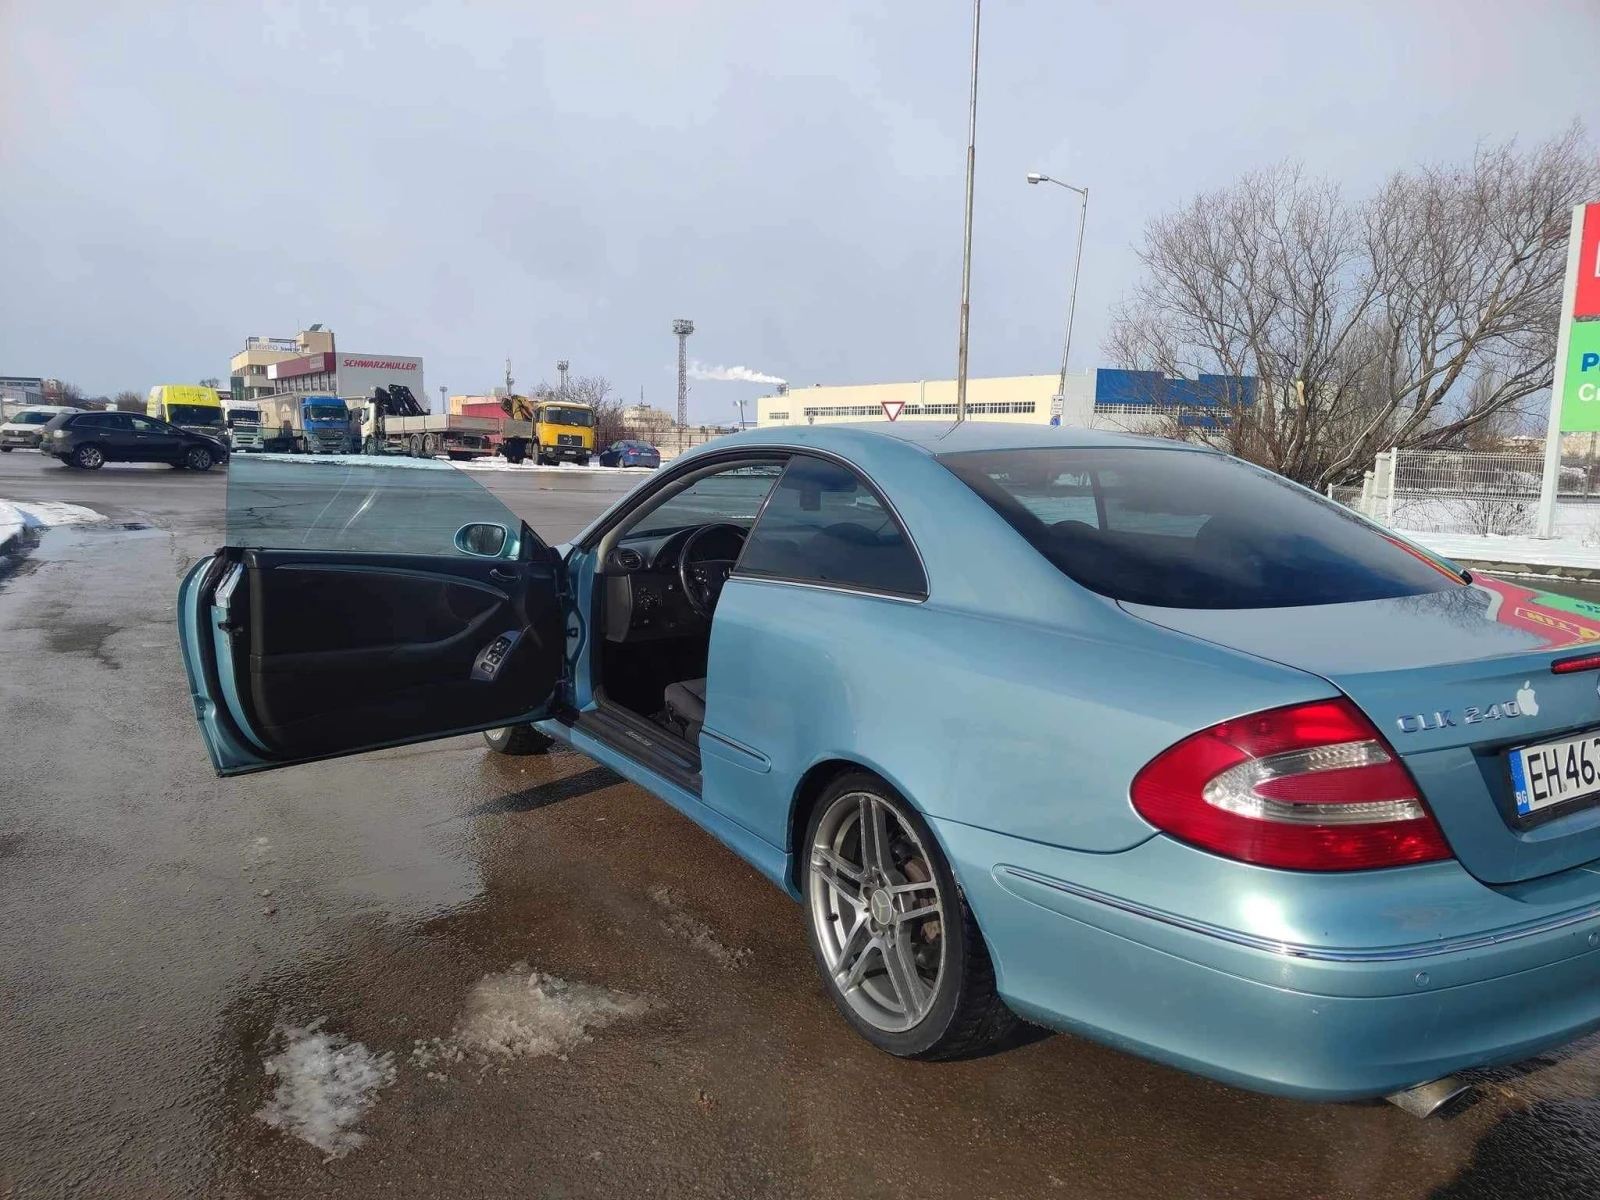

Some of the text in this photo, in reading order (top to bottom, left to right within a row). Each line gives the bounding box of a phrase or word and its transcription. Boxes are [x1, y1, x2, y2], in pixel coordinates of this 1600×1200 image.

[1581, 352, 1600, 372] P
[1396, 700, 1521, 733] CLK 240
[1515, 790, 1528, 806] BG
